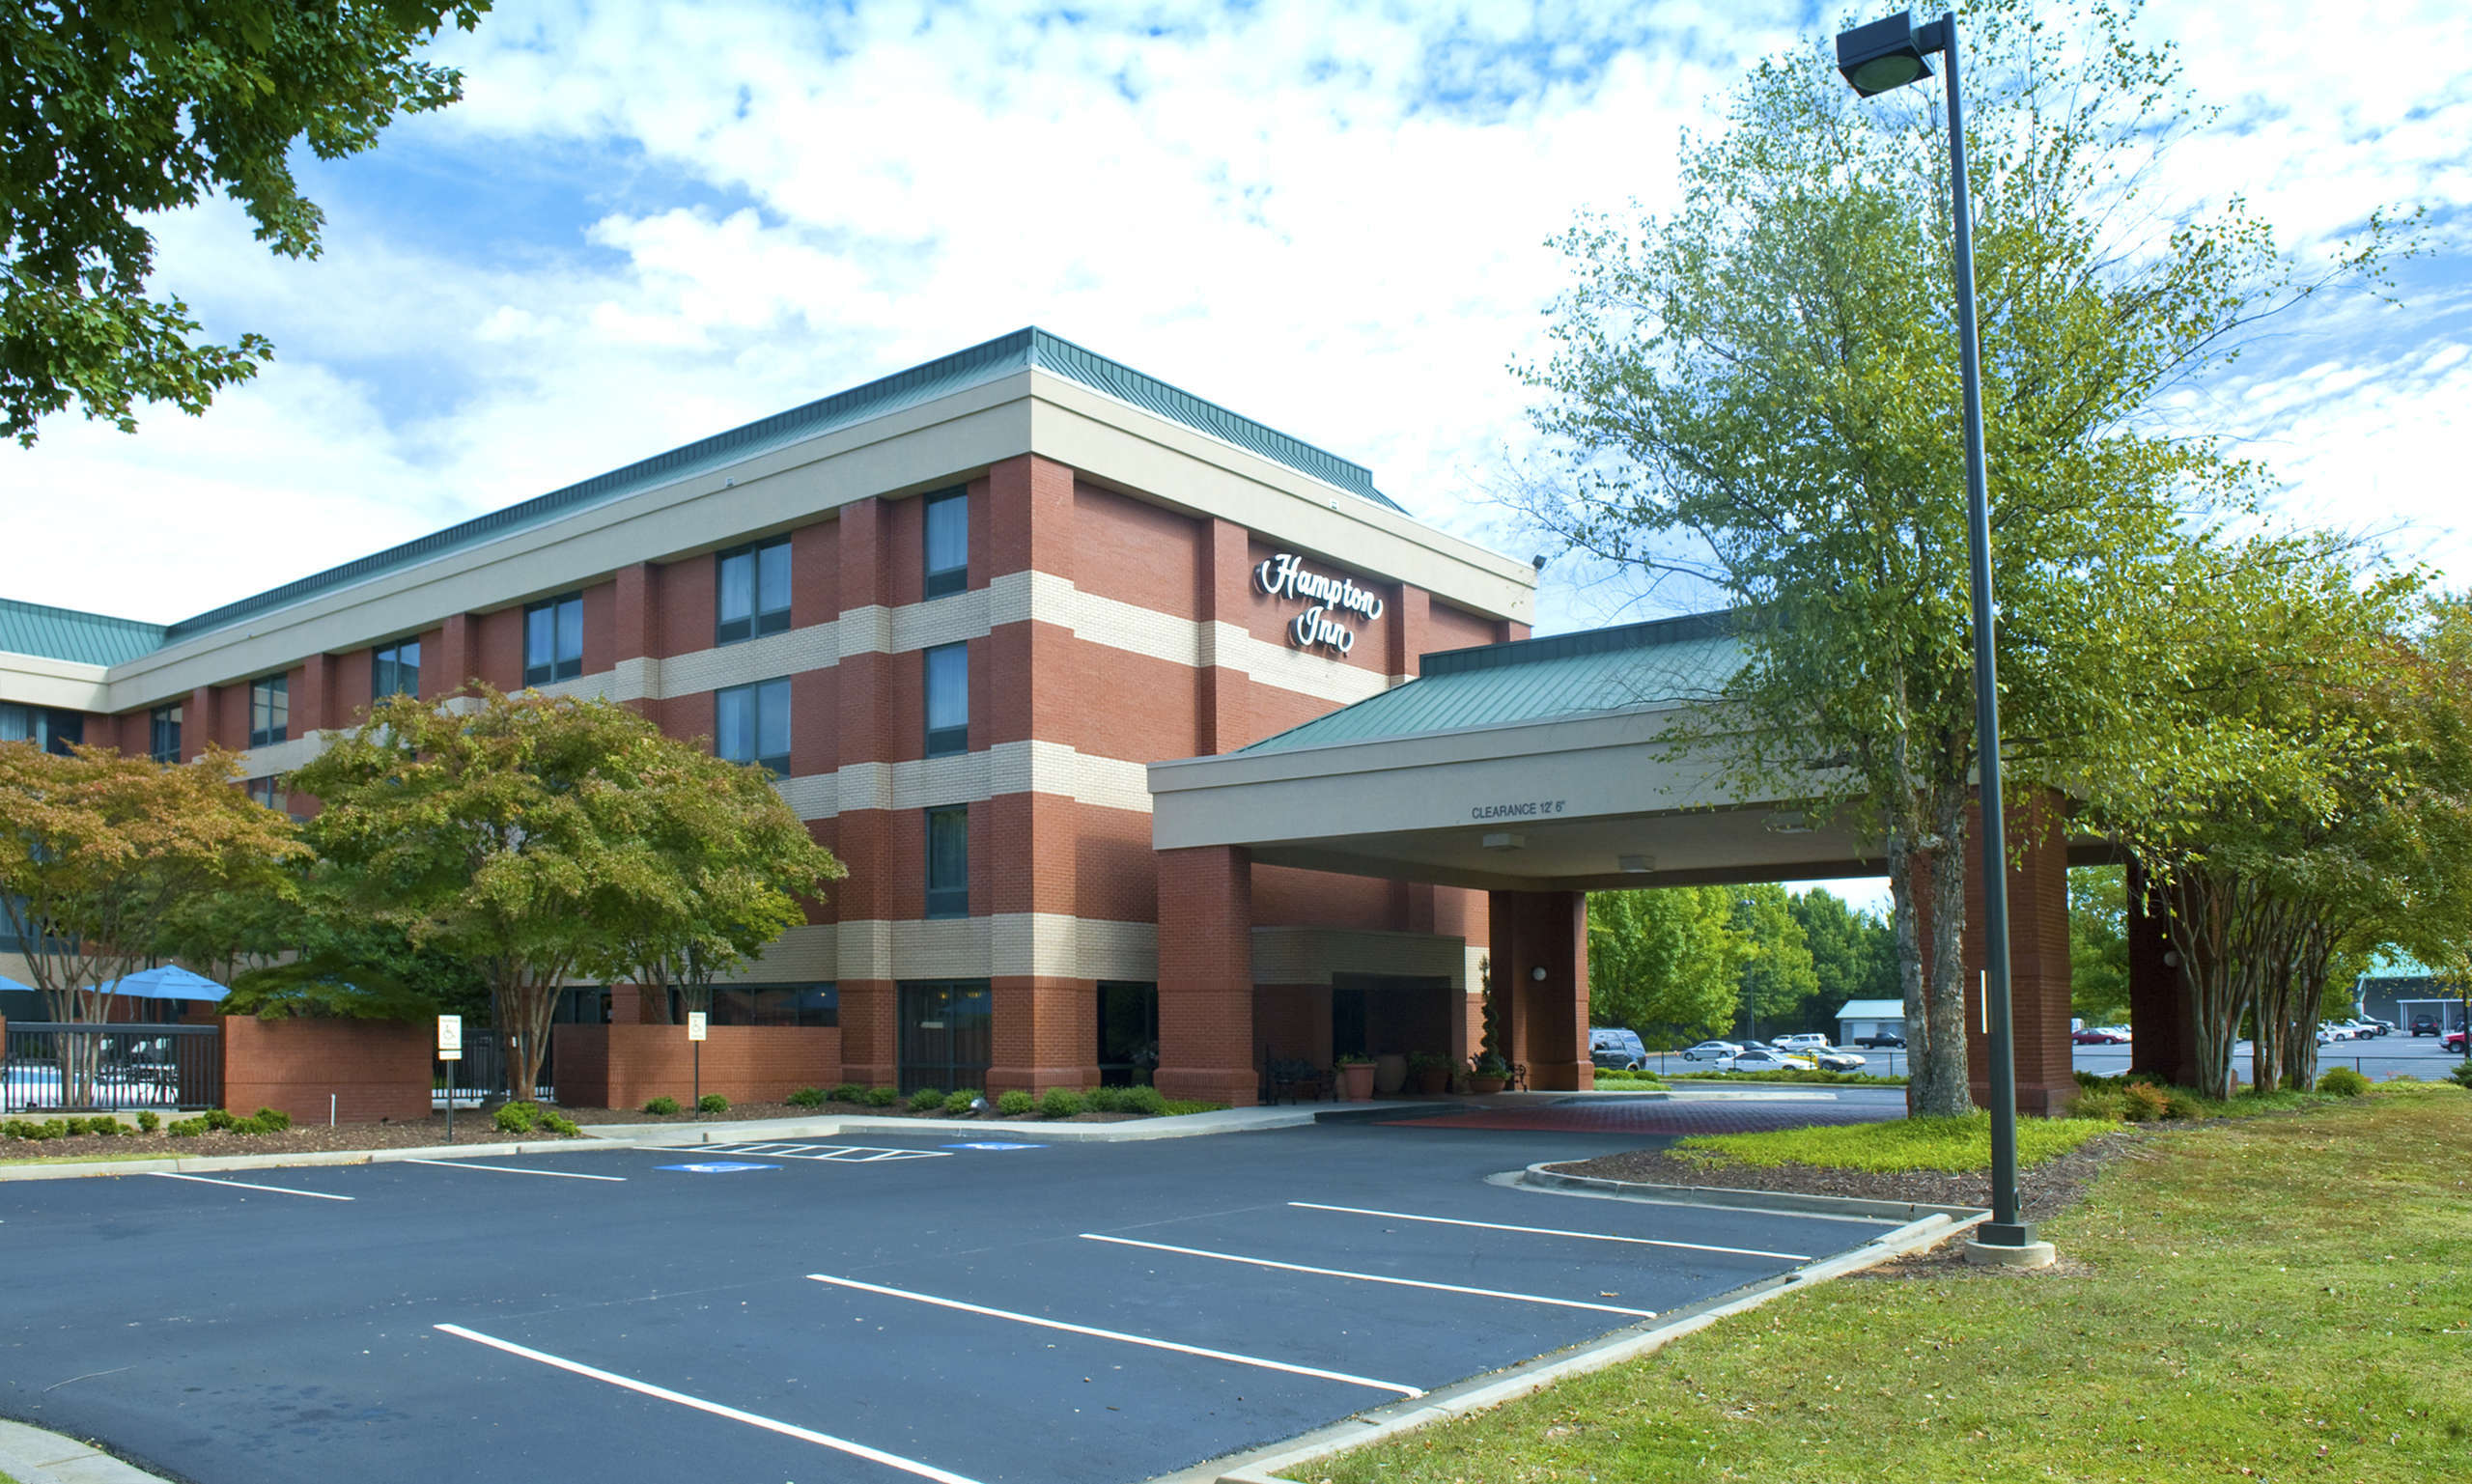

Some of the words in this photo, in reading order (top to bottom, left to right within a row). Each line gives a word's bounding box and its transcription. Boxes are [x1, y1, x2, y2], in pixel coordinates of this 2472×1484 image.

[1260, 553, 1383, 620] Hampton
[1296, 605, 1354, 653] Inn
[1472, 803, 1536, 819] CLEARANCE
